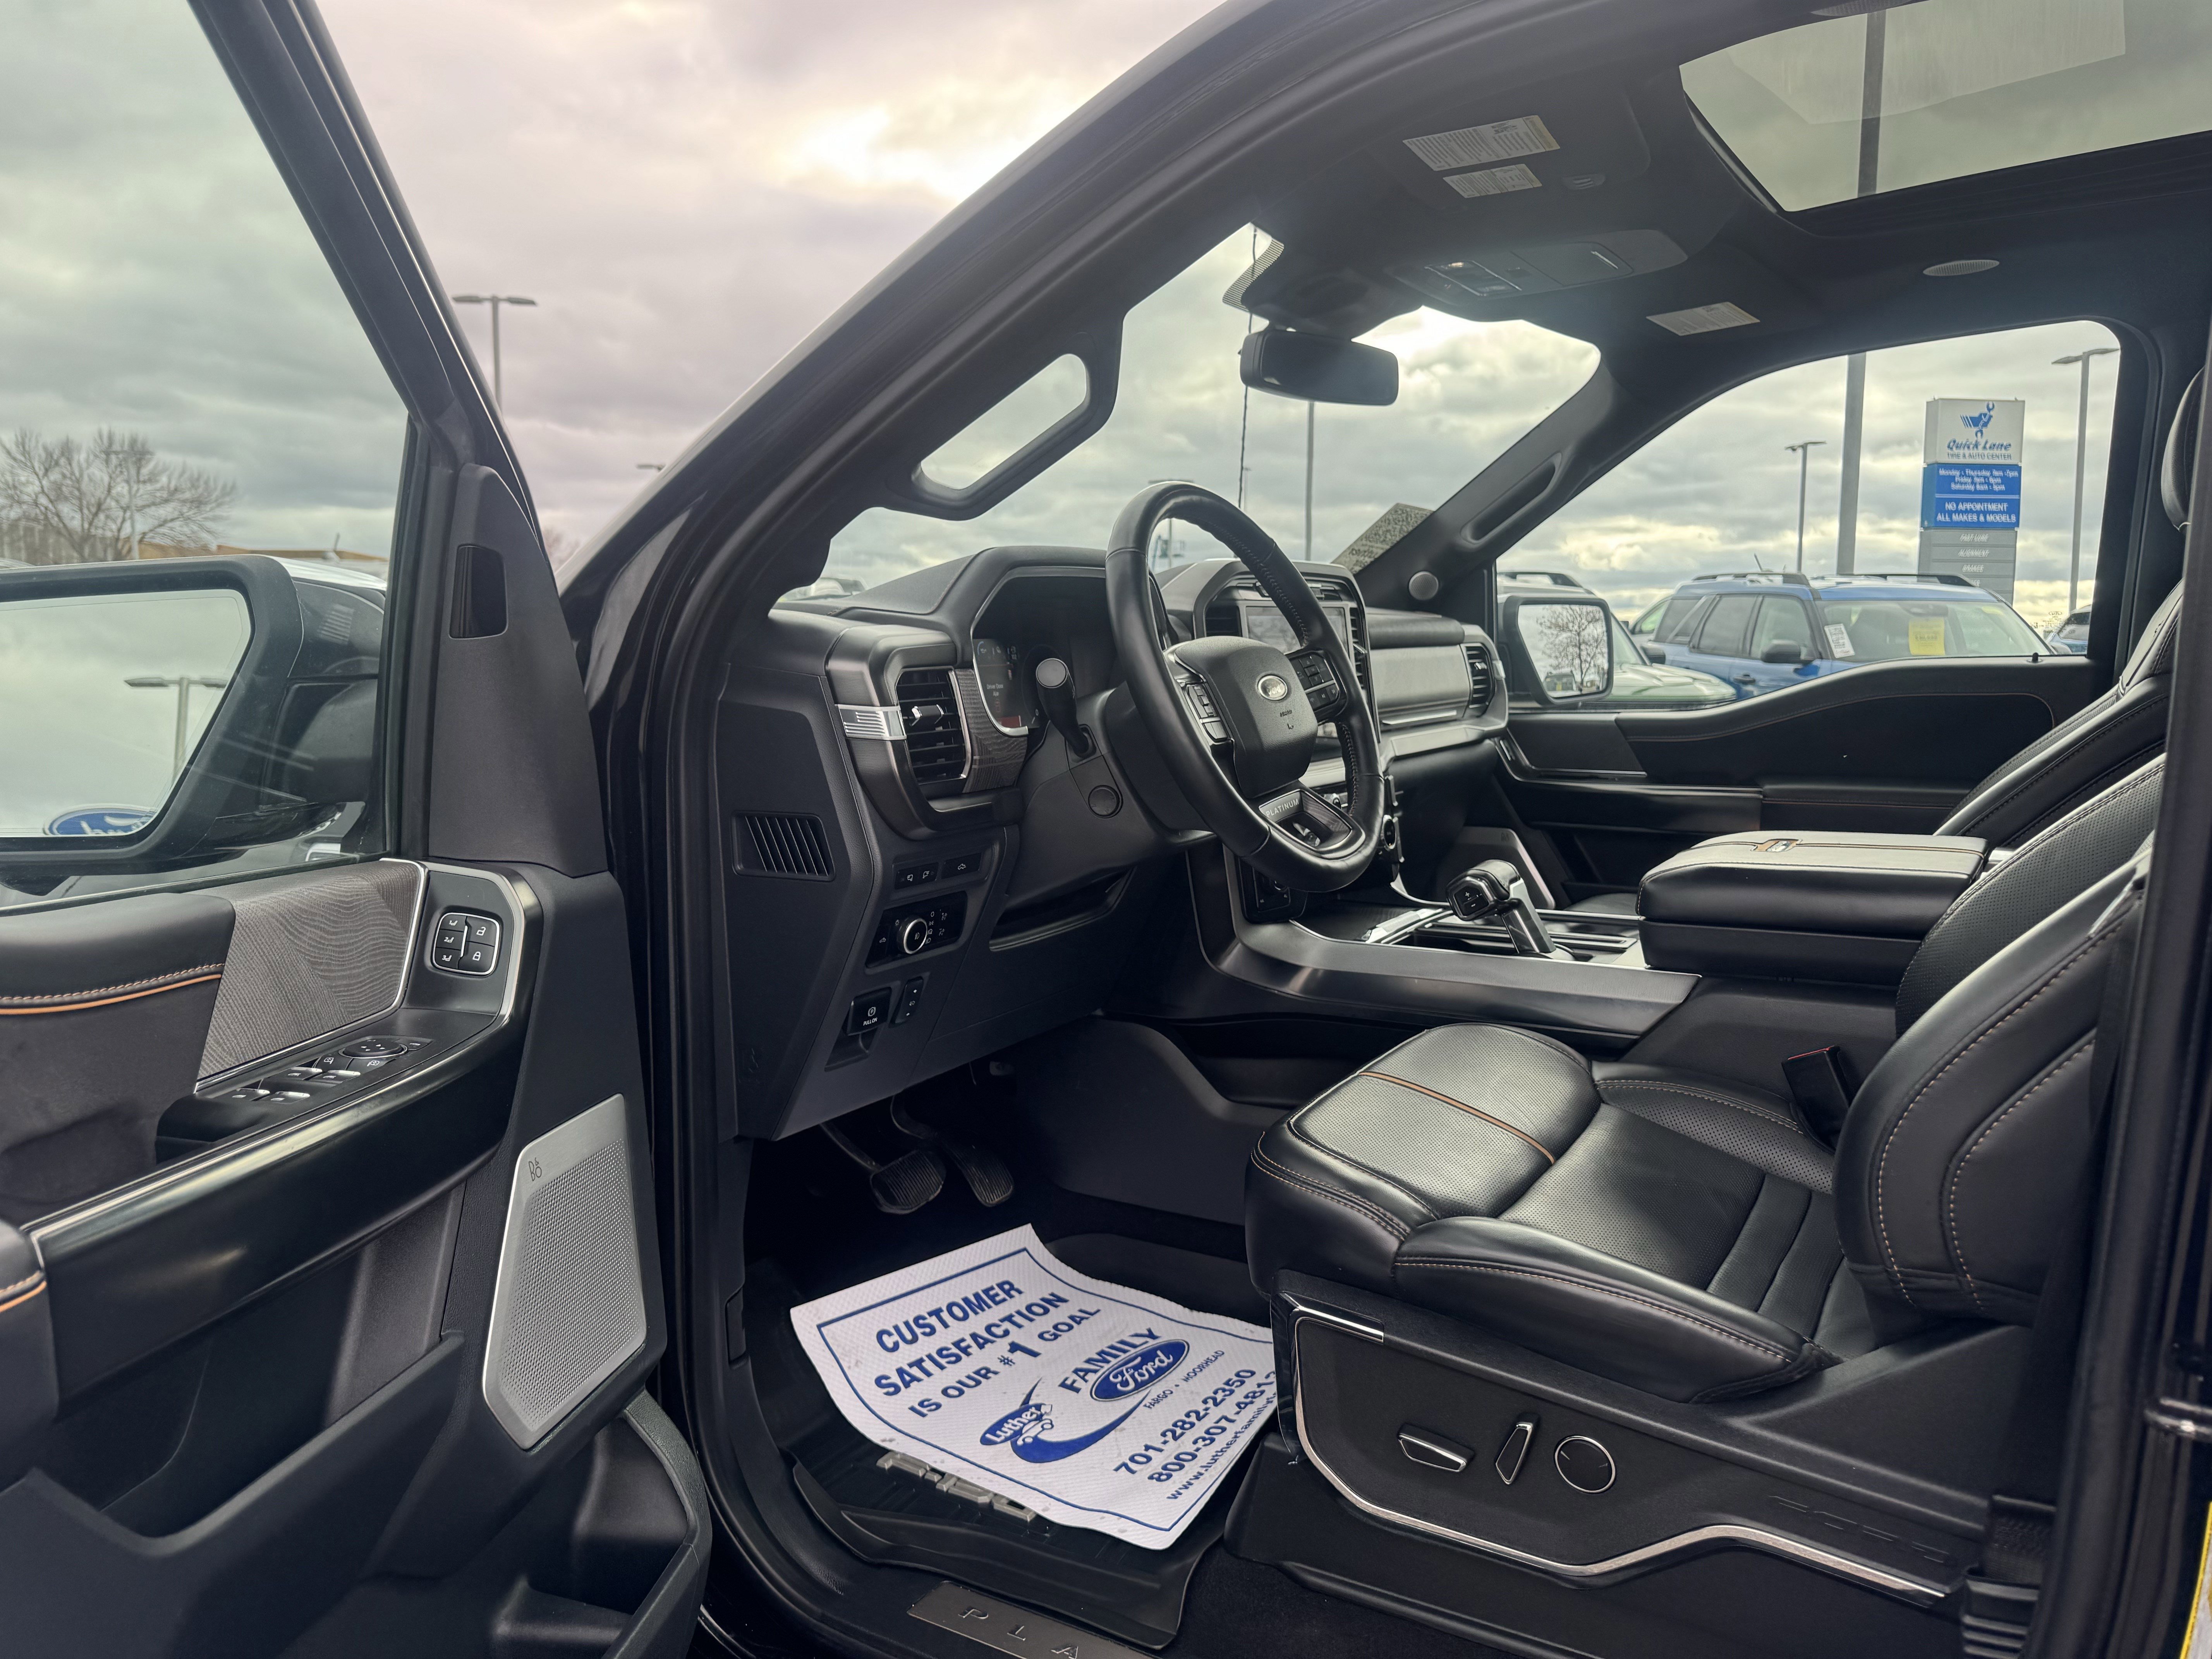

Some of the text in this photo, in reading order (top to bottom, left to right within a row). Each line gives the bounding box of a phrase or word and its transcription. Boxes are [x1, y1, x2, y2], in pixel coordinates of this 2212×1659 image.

[1947, 438, 2011, 451] Quick Lane
[1939, 468, 1960, 477] Monday
[1965, 469, 1991, 477] Thursday
[1951, 482, 1975, 491] Saturday
[1937, 513, 2016, 522] ALL MAKES & MODELS
[1945, 501, 2008, 511] NO APPOINTMENT
[1266, 799, 1299, 817] PLATINUM
[876, 1279, 1025, 1353] CUSTOMER
[874, 1291, 1070, 1396] SATISFACTION
[908, 1307, 1101, 1418] IS OUR #1 GOAL
[1058, 1327, 1161, 1394] FAMILY
[1109, 1350, 1173, 1391] Ford
[1143, 1350, 1225, 1409] FARGO MOORHEAD
[985, 1405, 1044, 1444] Luther
[1113, 1369, 1256, 1475] 701-282-2350
